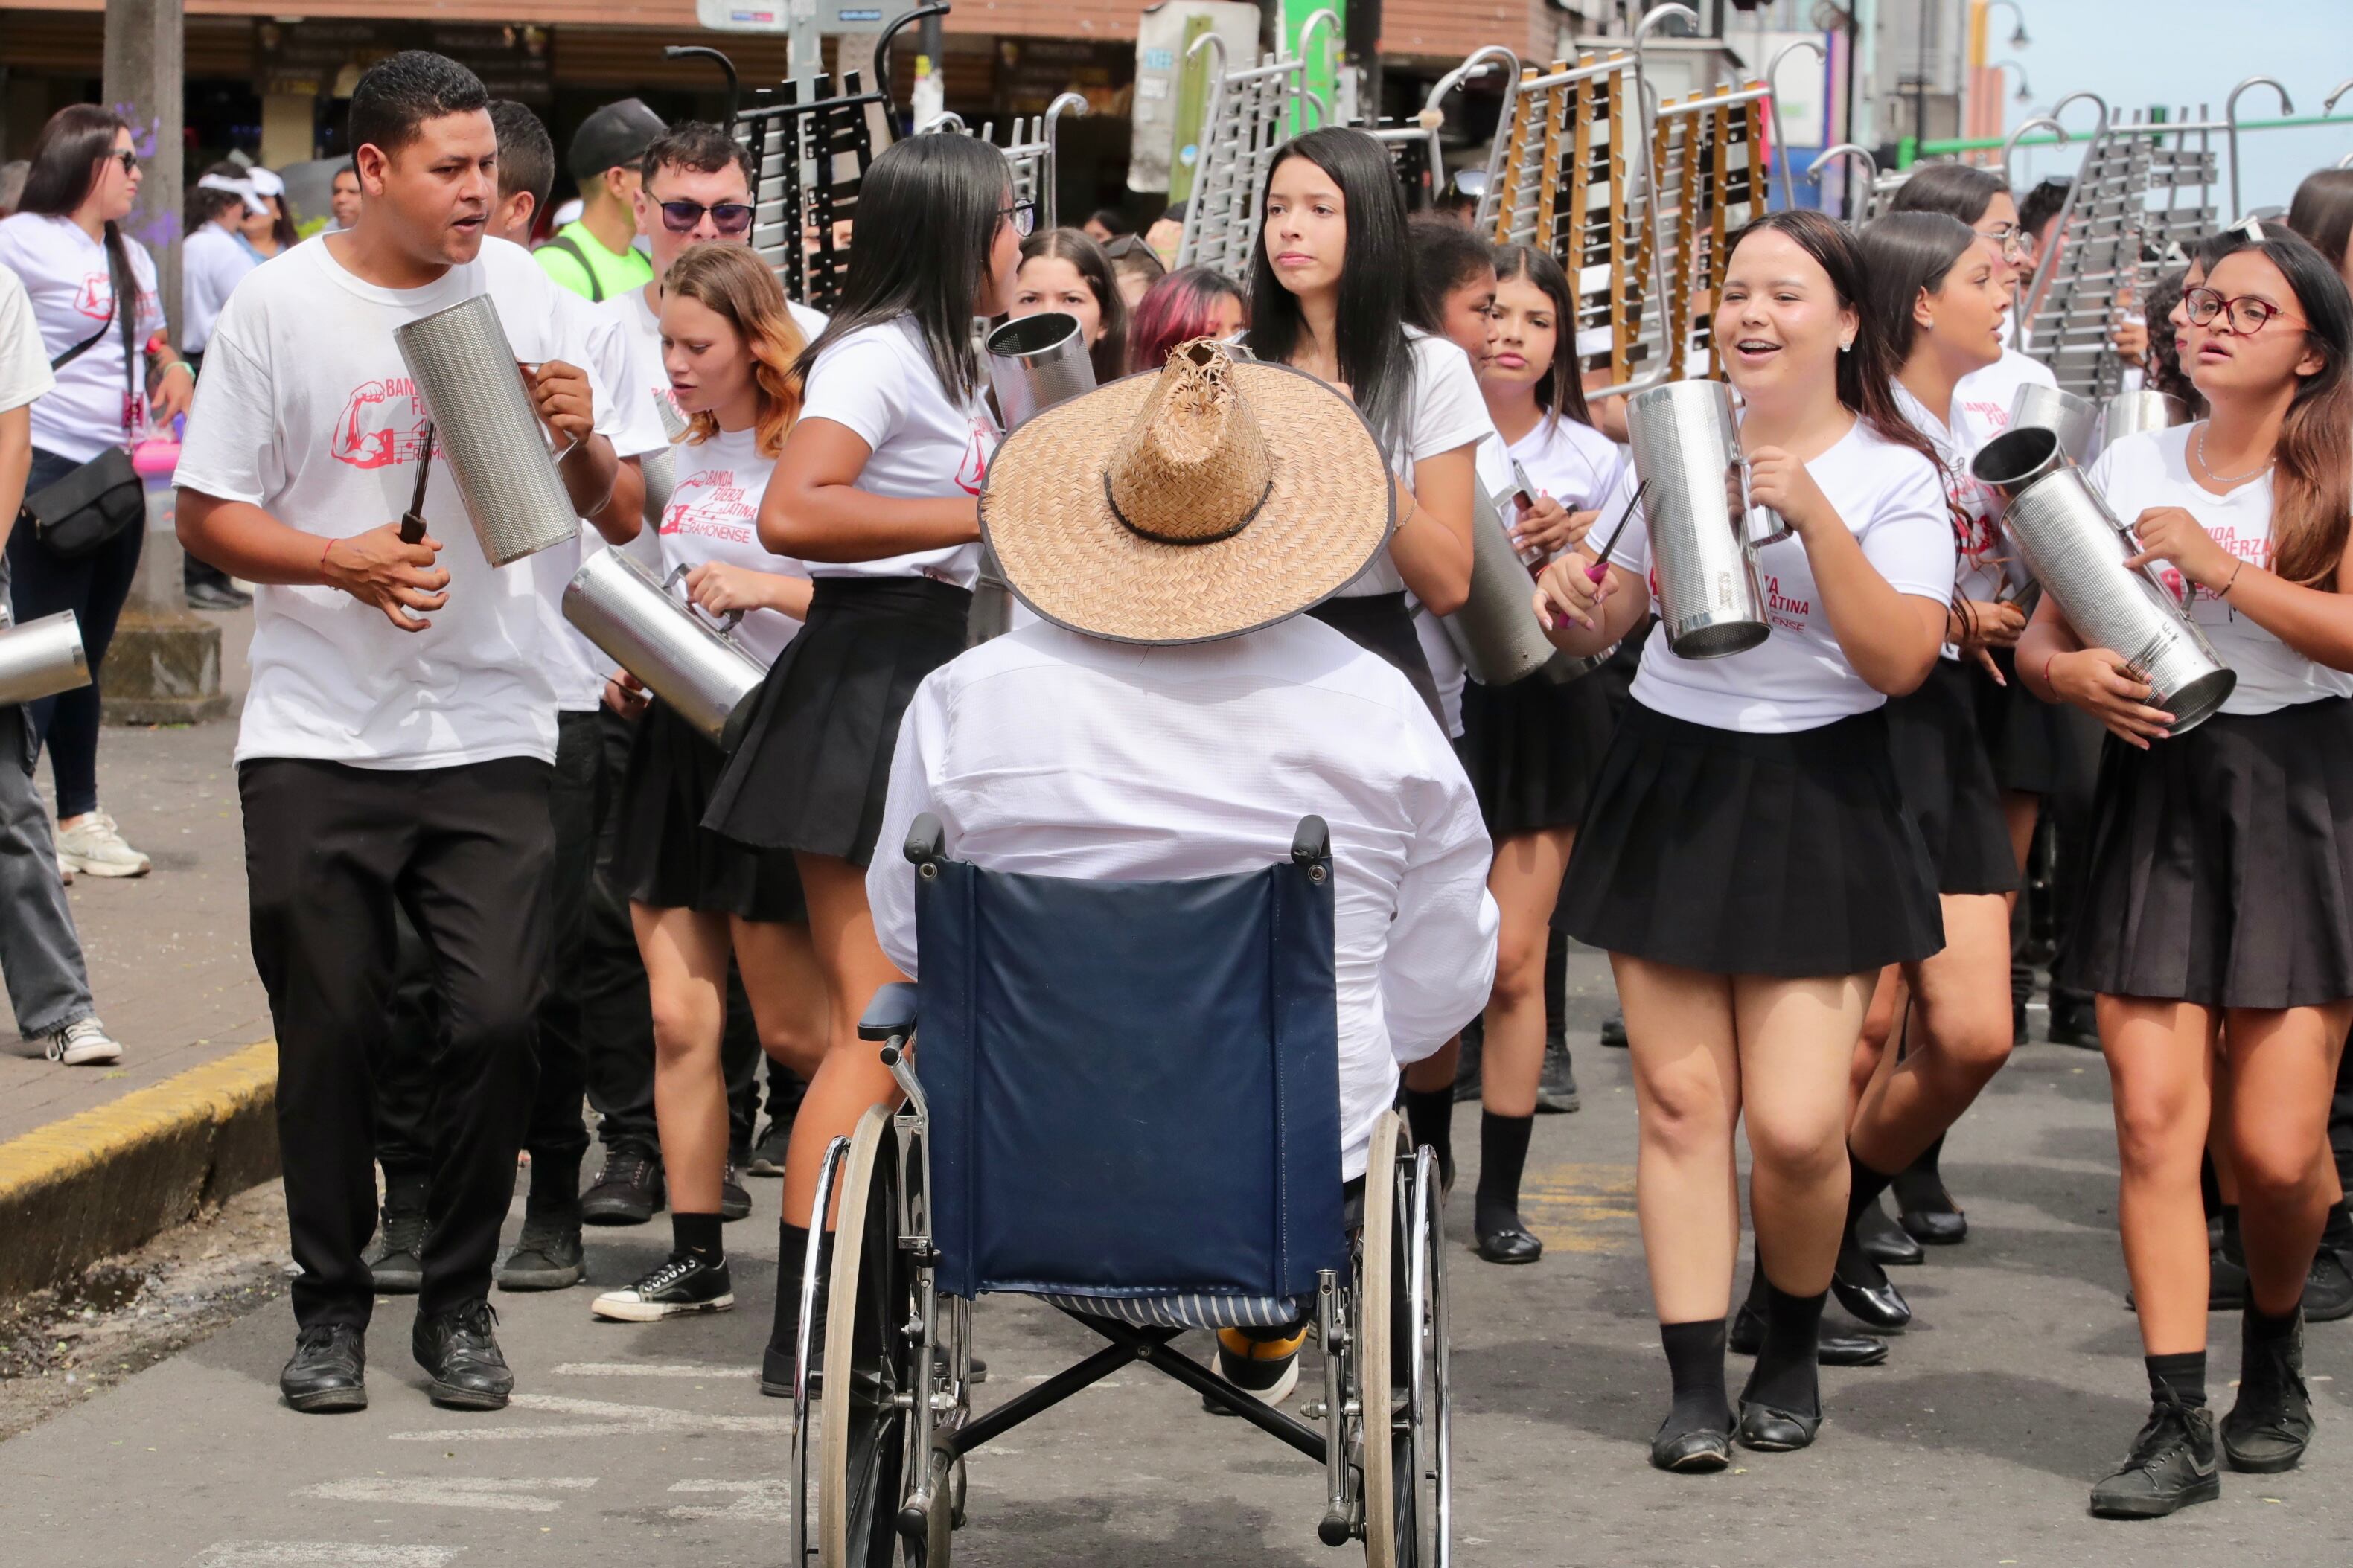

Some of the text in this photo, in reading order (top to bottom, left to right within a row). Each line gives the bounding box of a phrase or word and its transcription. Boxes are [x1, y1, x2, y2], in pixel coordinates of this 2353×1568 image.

[386, 378, 419, 397] BAN
[706, 470, 734, 488] BANDA
[709, 487, 746, 502] FUERZA
[722, 502, 758, 520] LATINA
[690, 522, 751, 544] RAMONENSE
[1769, 594, 1810, 616] ATINA
